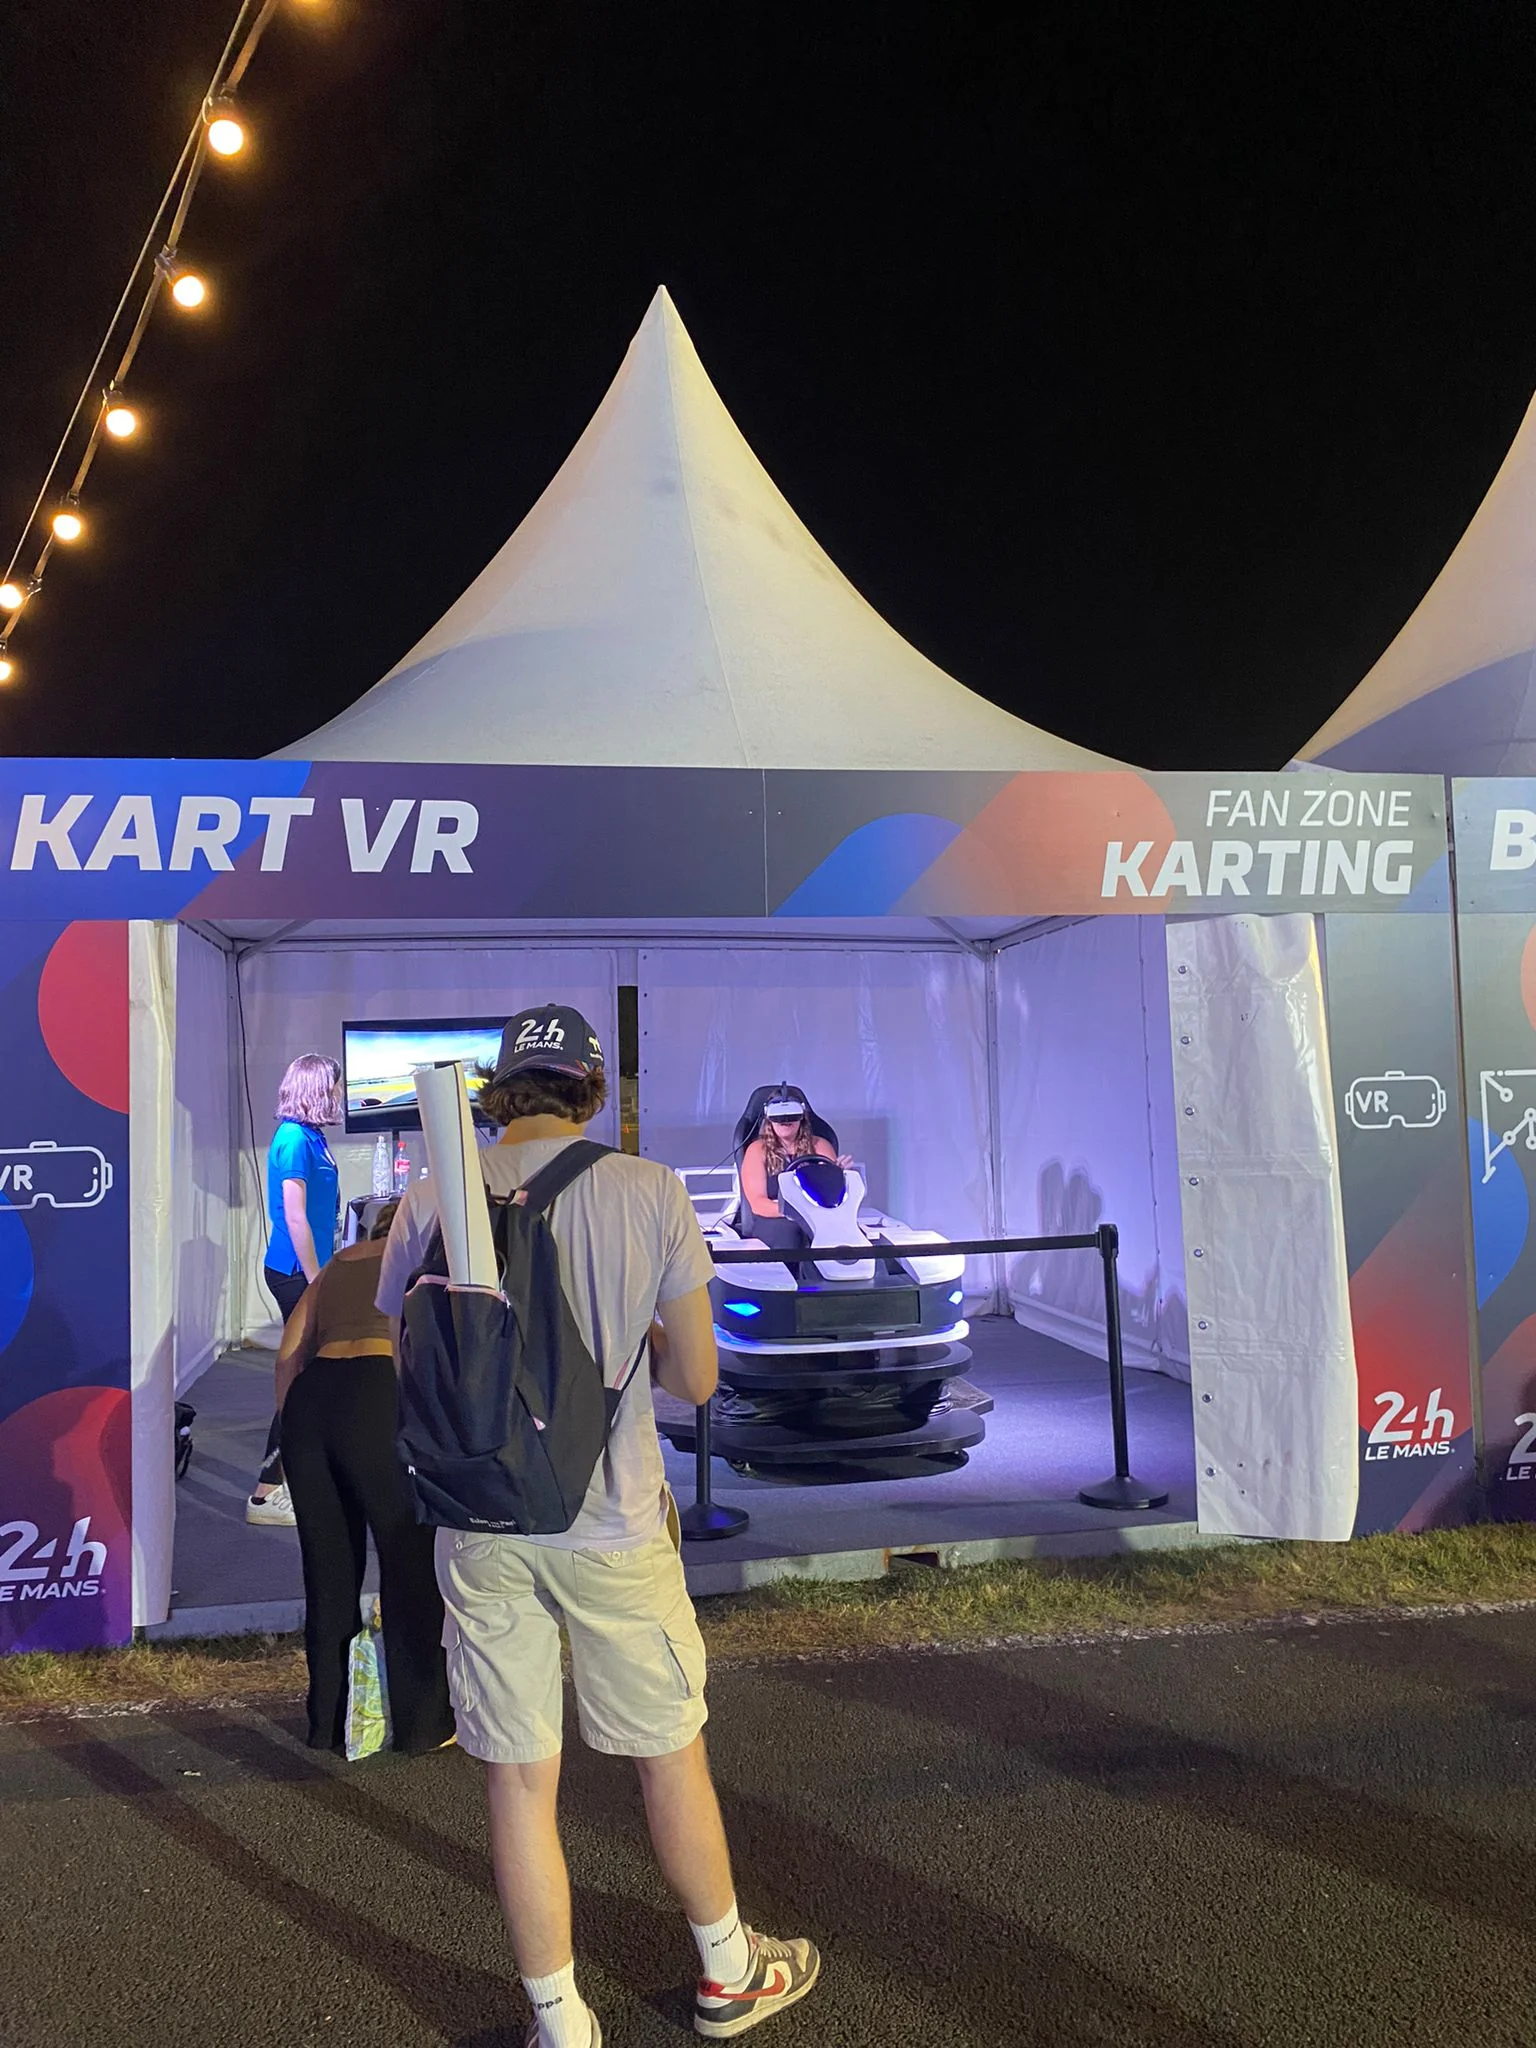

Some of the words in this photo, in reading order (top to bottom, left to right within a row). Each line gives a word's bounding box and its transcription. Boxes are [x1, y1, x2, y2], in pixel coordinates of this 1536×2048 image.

[1206, 789, 1290, 827] FAN
[1299, 789, 1413, 827] ZONE
[10, 794, 315, 872] KART
[340, 798, 480, 873] VR
[1101, 839, 1414, 898] KARTING
[515, 1018, 565, 1045] 24h
[514, 1044, 525, 1054] LE
[1355, 1090, 1389, 1114] VR
[1367, 1387, 1455, 1444] 24h
[1364, 1445, 1390, 1461] LE
[1392, 1441, 1450, 1459] MANS
[1506, 1466, 1532, 1480] LE
[0, 1516, 108, 1581] 24h
